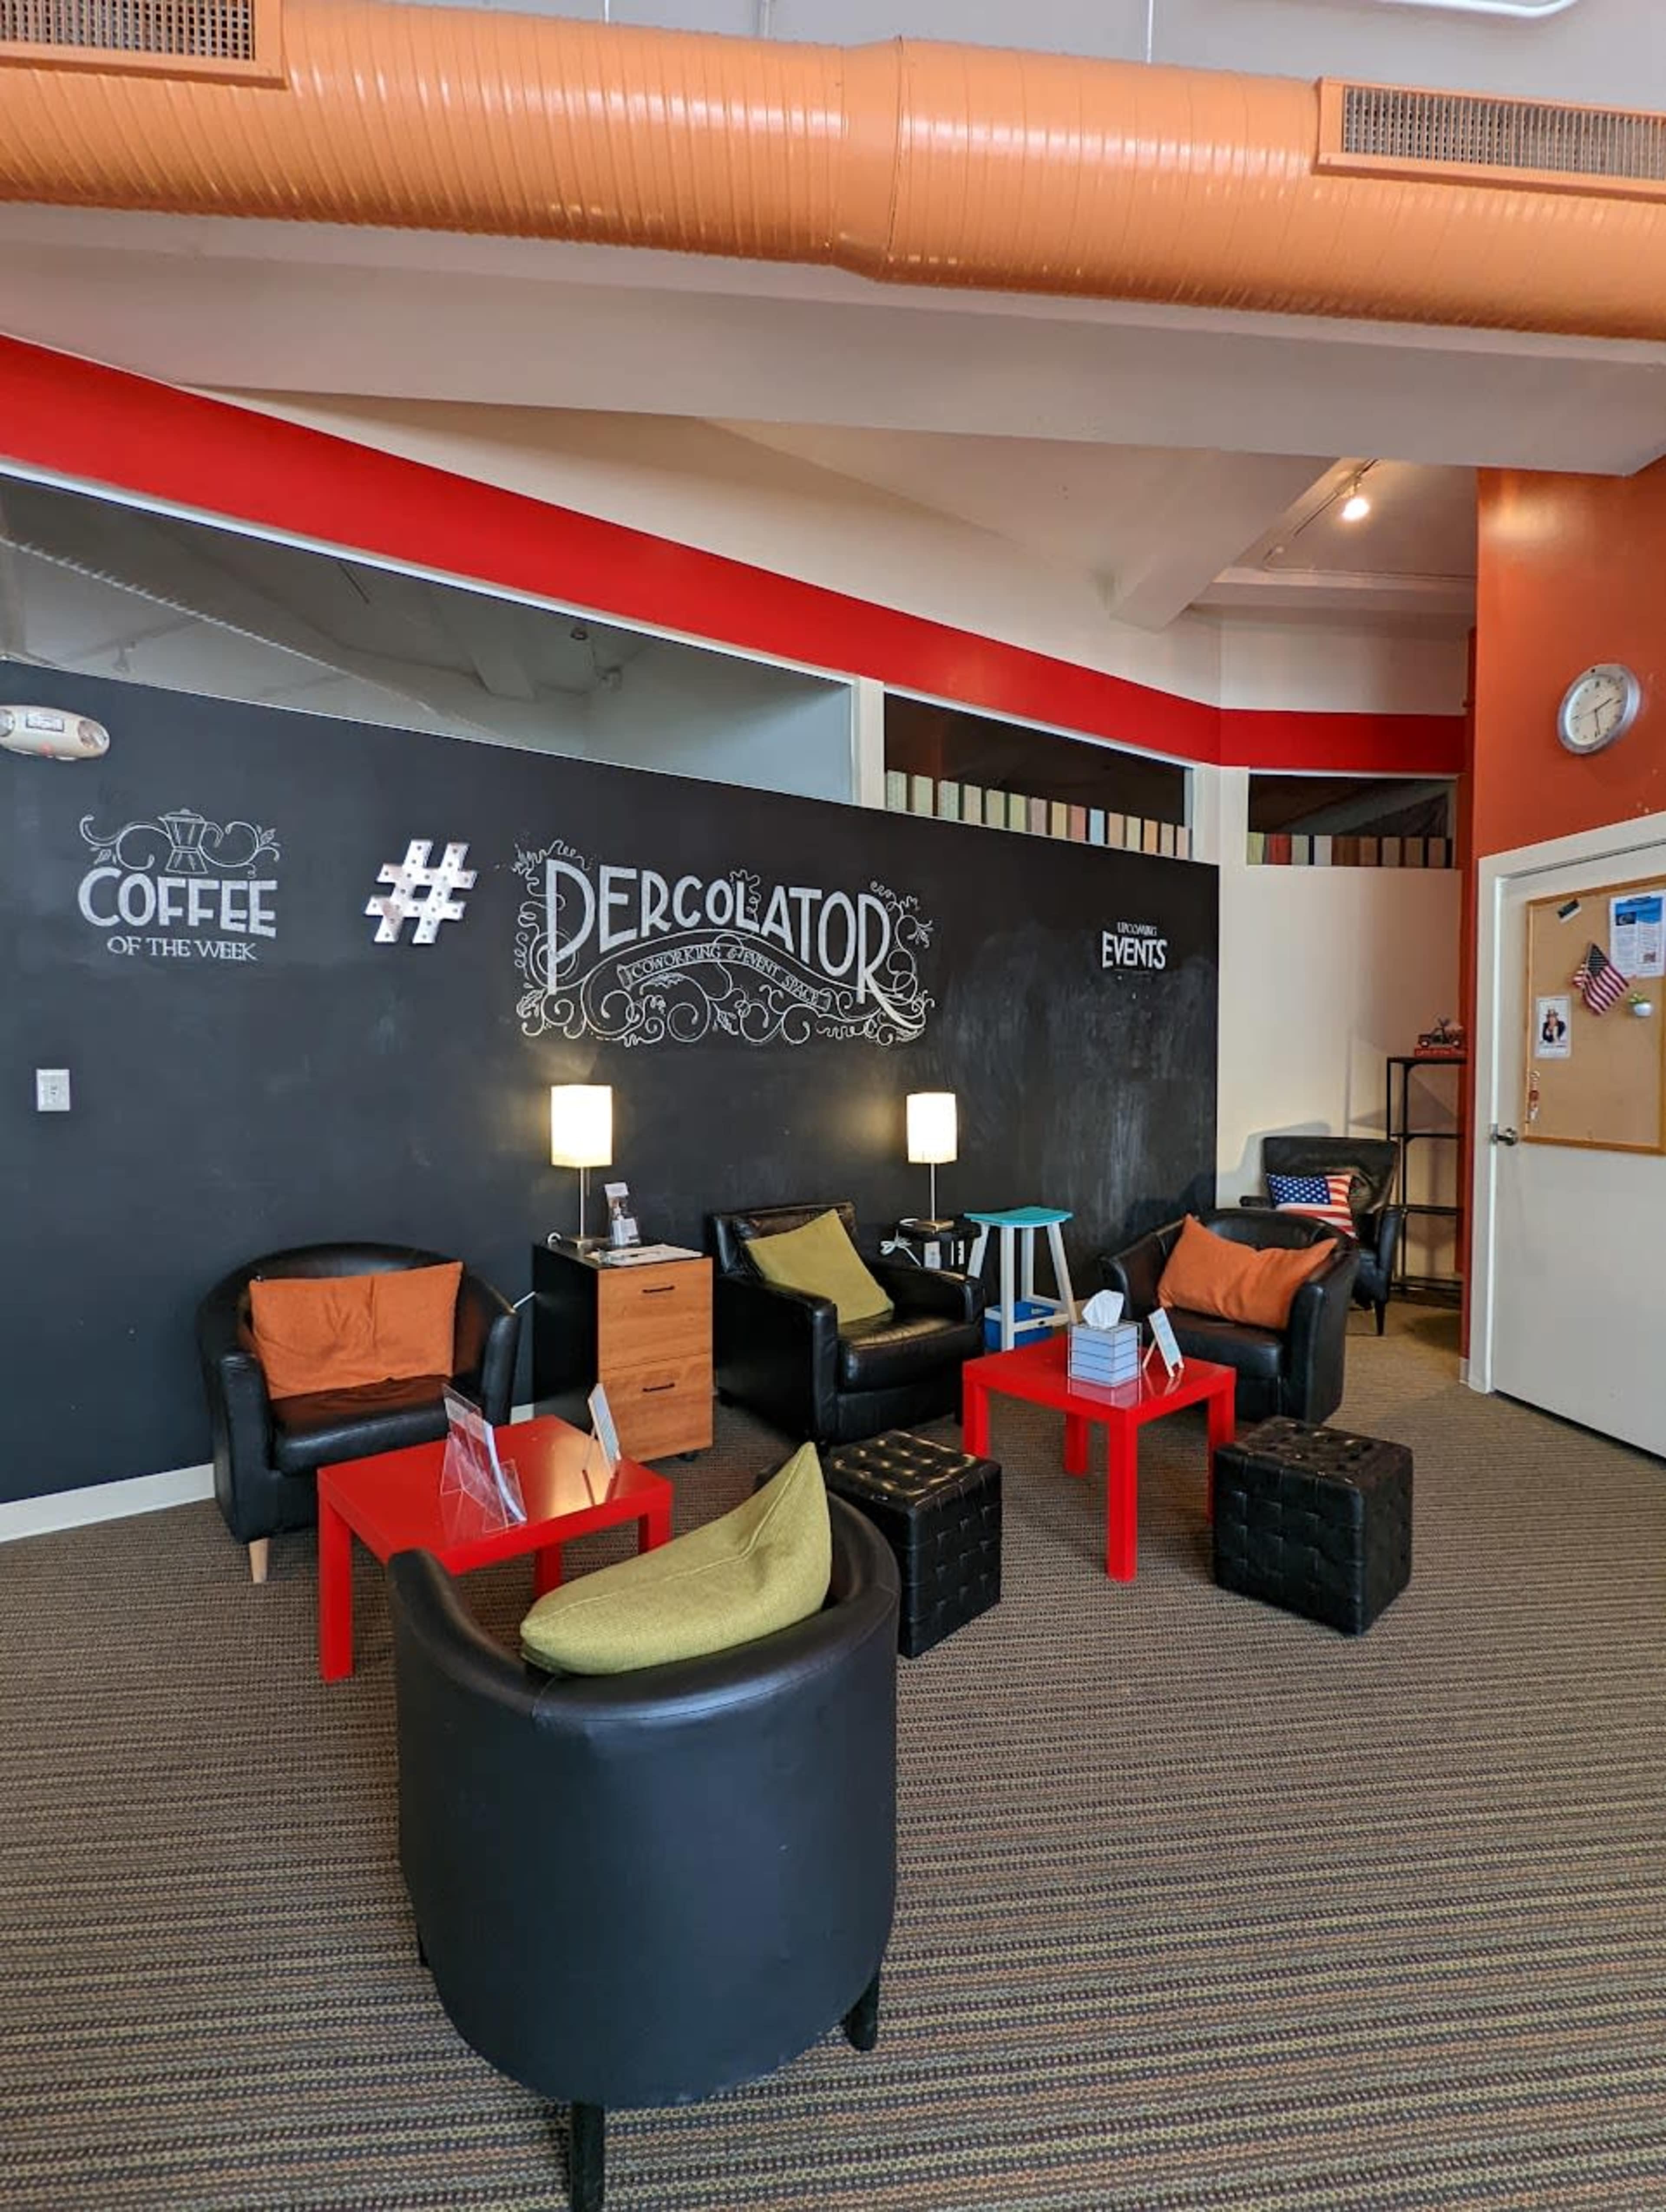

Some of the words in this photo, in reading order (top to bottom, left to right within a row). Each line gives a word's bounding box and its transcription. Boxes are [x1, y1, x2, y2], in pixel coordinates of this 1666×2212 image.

[78, 866, 278, 938] COFFEE
[107, 935, 142, 956] OF
[146, 937, 192, 957] THE
[193, 940, 259, 961] WEEK
[545, 859, 926, 1029] PERCOLATOR
[1102, 931, 1167, 970] EVENTS
[1116, 921, 1158, 936] UPCOMING
[632, 946, 721, 978] COWORKING
[743, 950, 780, 977] EVENT
[781, 974, 820, 1005] SPACE
